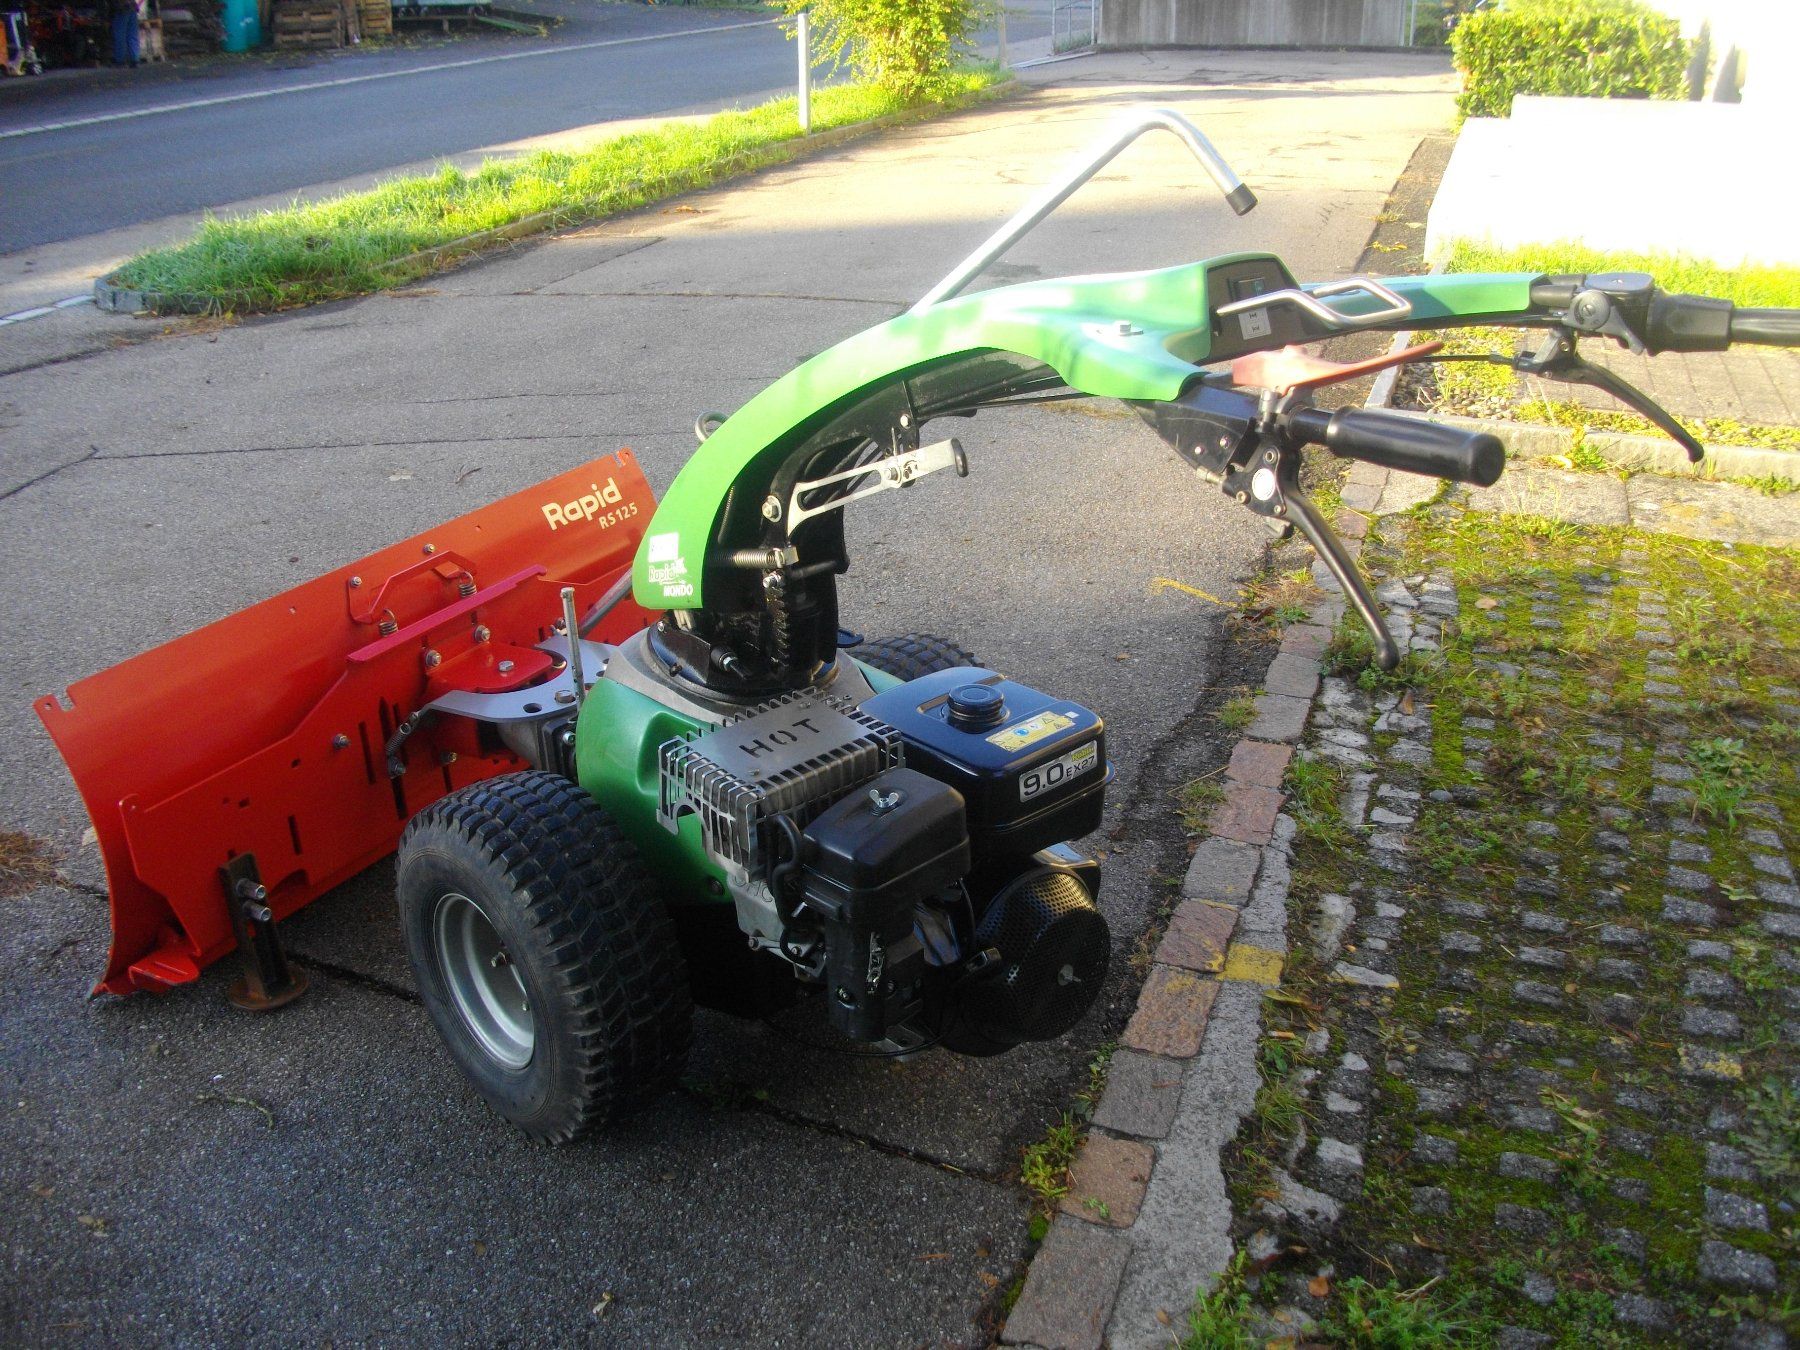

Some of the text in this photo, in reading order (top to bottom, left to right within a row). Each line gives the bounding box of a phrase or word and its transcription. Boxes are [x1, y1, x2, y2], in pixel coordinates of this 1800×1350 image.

[541, 477, 622, 530] Rapid
[664, 584, 693, 597] MONDO
[739, 719, 820, 758] HOT
[1023, 756, 1095, 796] 9.0 EX27
